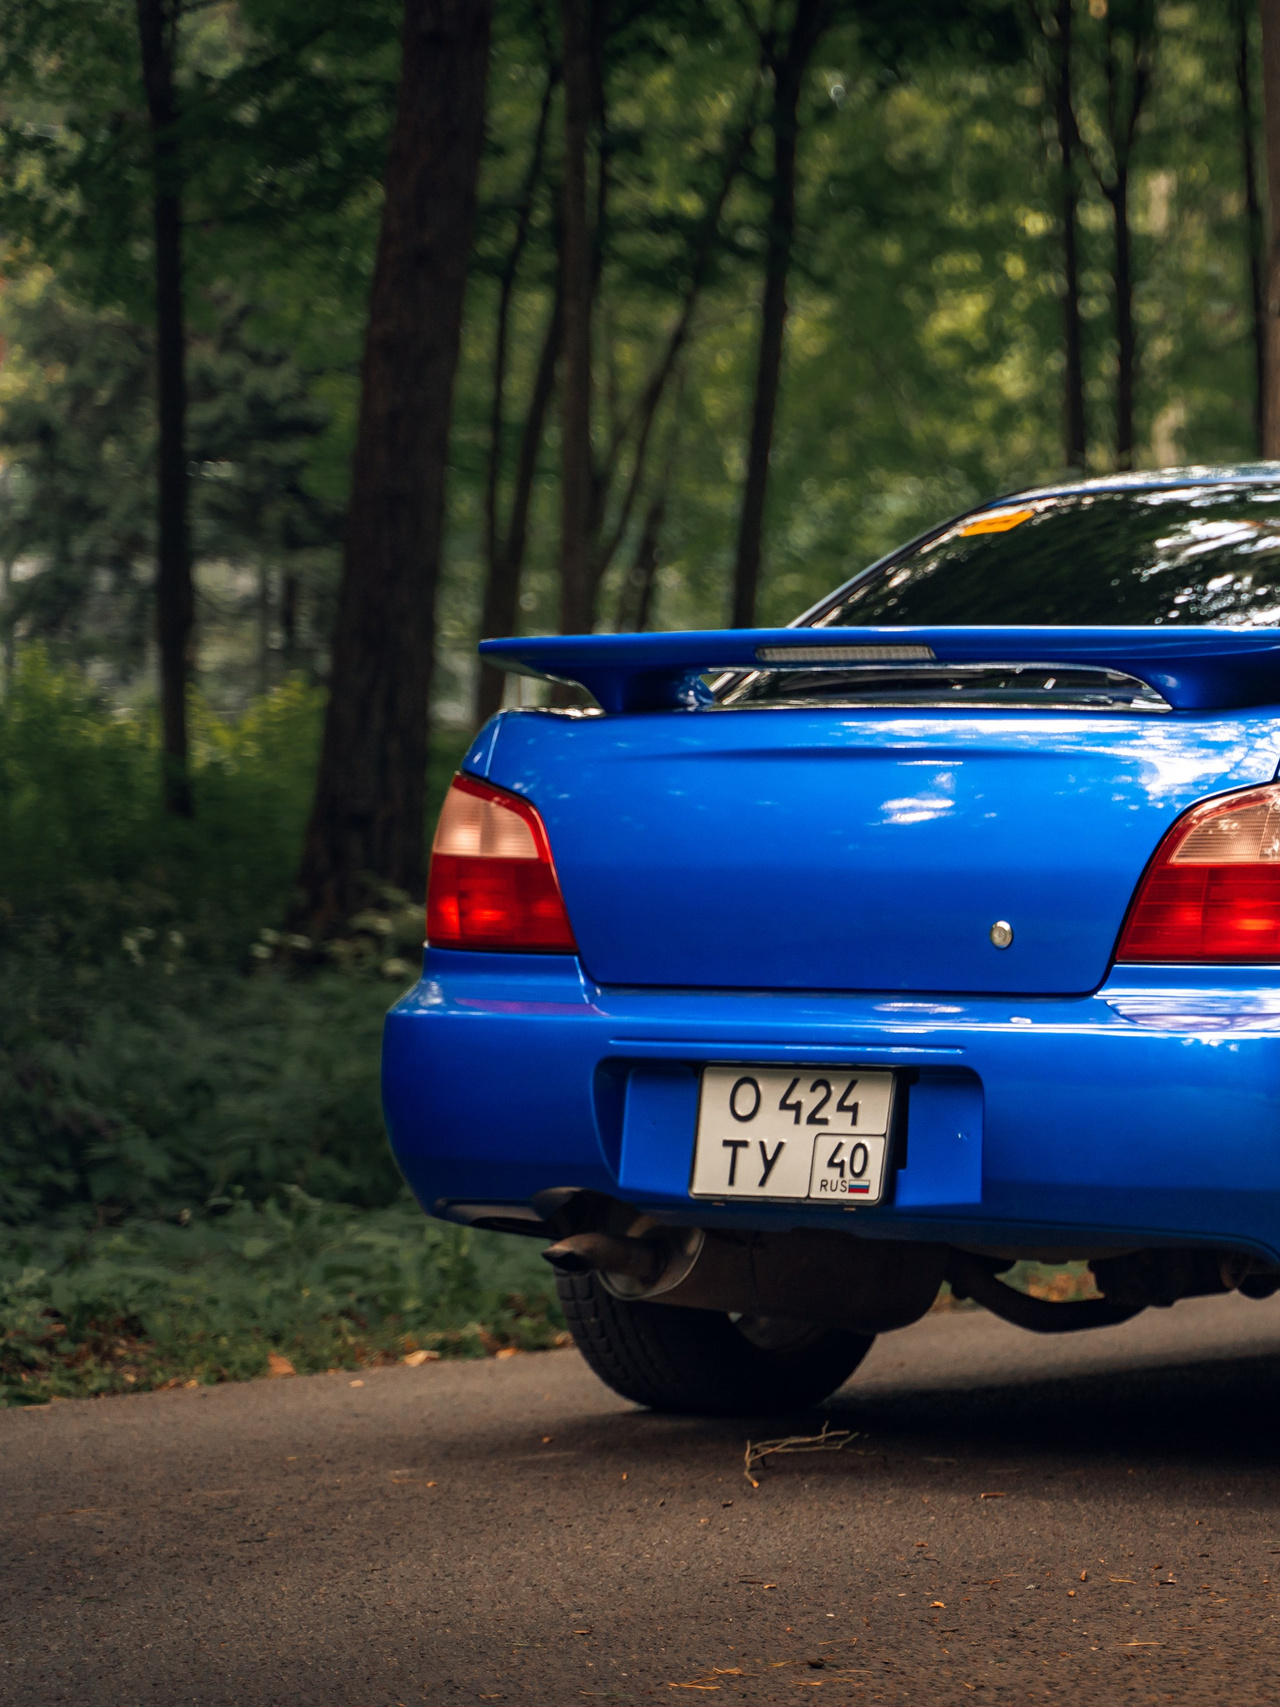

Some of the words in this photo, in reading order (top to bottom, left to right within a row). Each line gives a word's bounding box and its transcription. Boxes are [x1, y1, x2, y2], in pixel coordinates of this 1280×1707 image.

[778, 1077, 860, 1127] 424
[826, 1141, 869, 1178] 40
[819, 1179, 848, 1193] RUS
